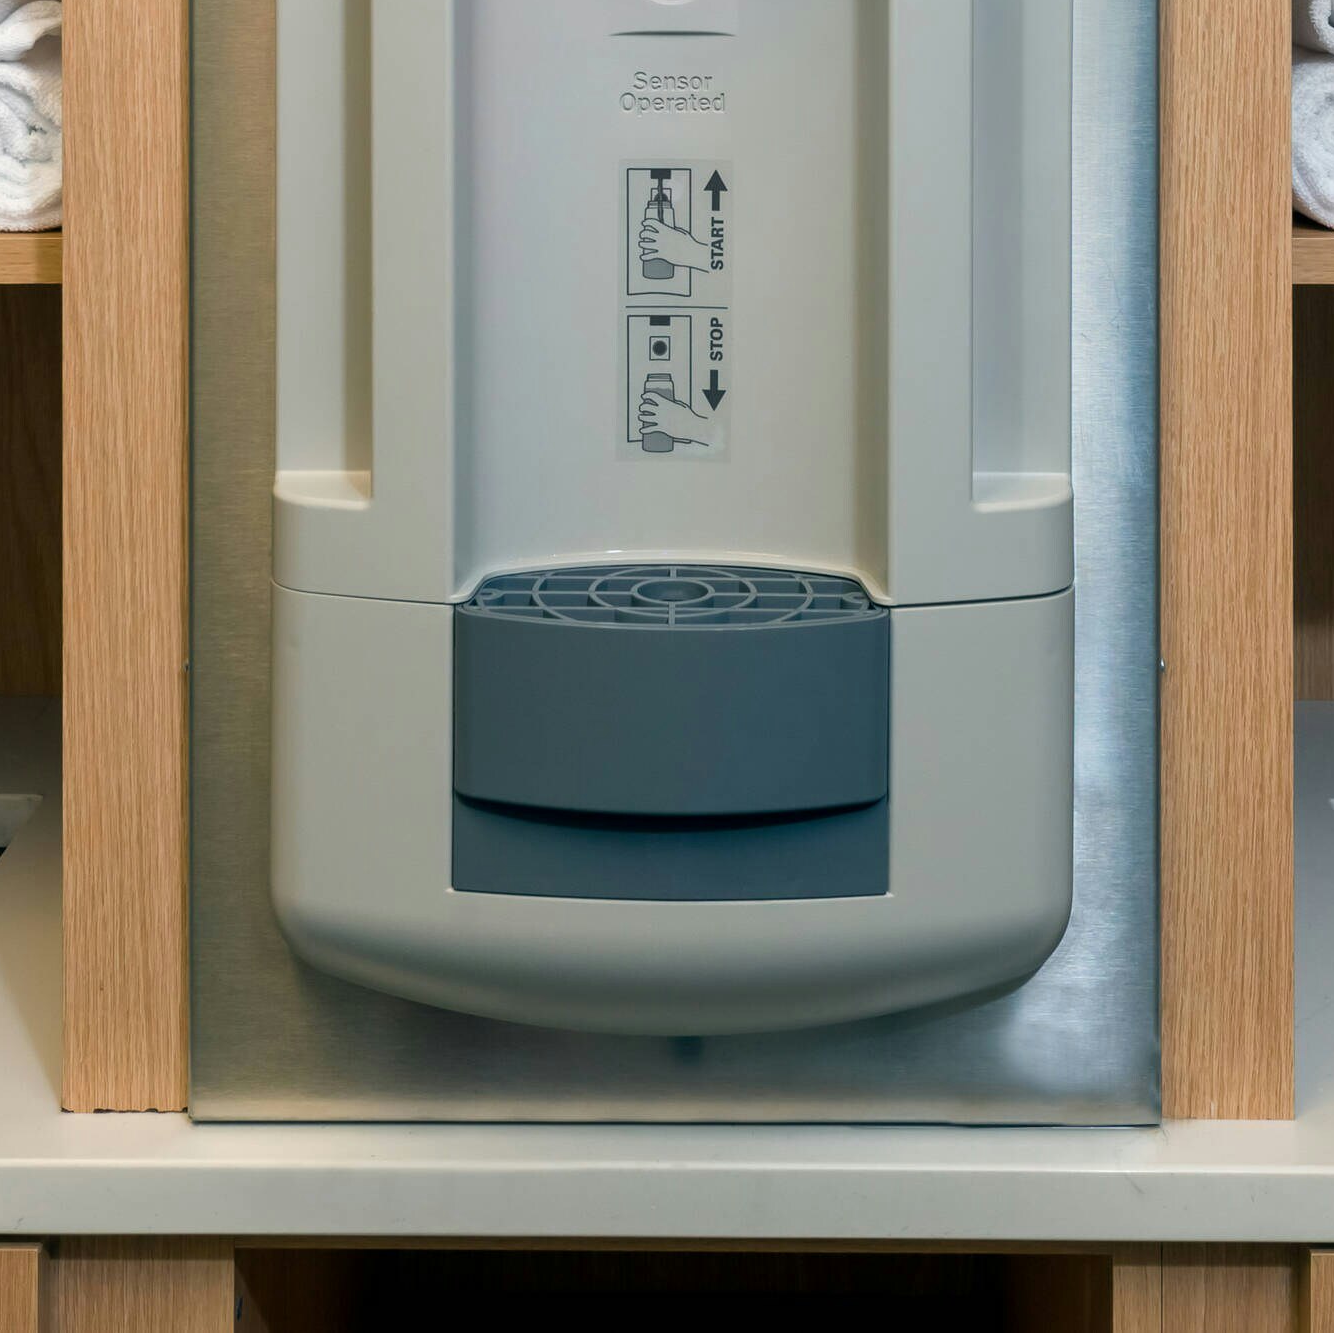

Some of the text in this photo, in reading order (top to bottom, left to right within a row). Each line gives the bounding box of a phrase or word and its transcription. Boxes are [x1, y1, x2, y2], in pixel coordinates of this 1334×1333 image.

[633, 71, 713, 91] Sensor
[619, 92, 726, 118] Operated
[710, 216, 725, 271] START
[709, 317, 724, 361] STOP
